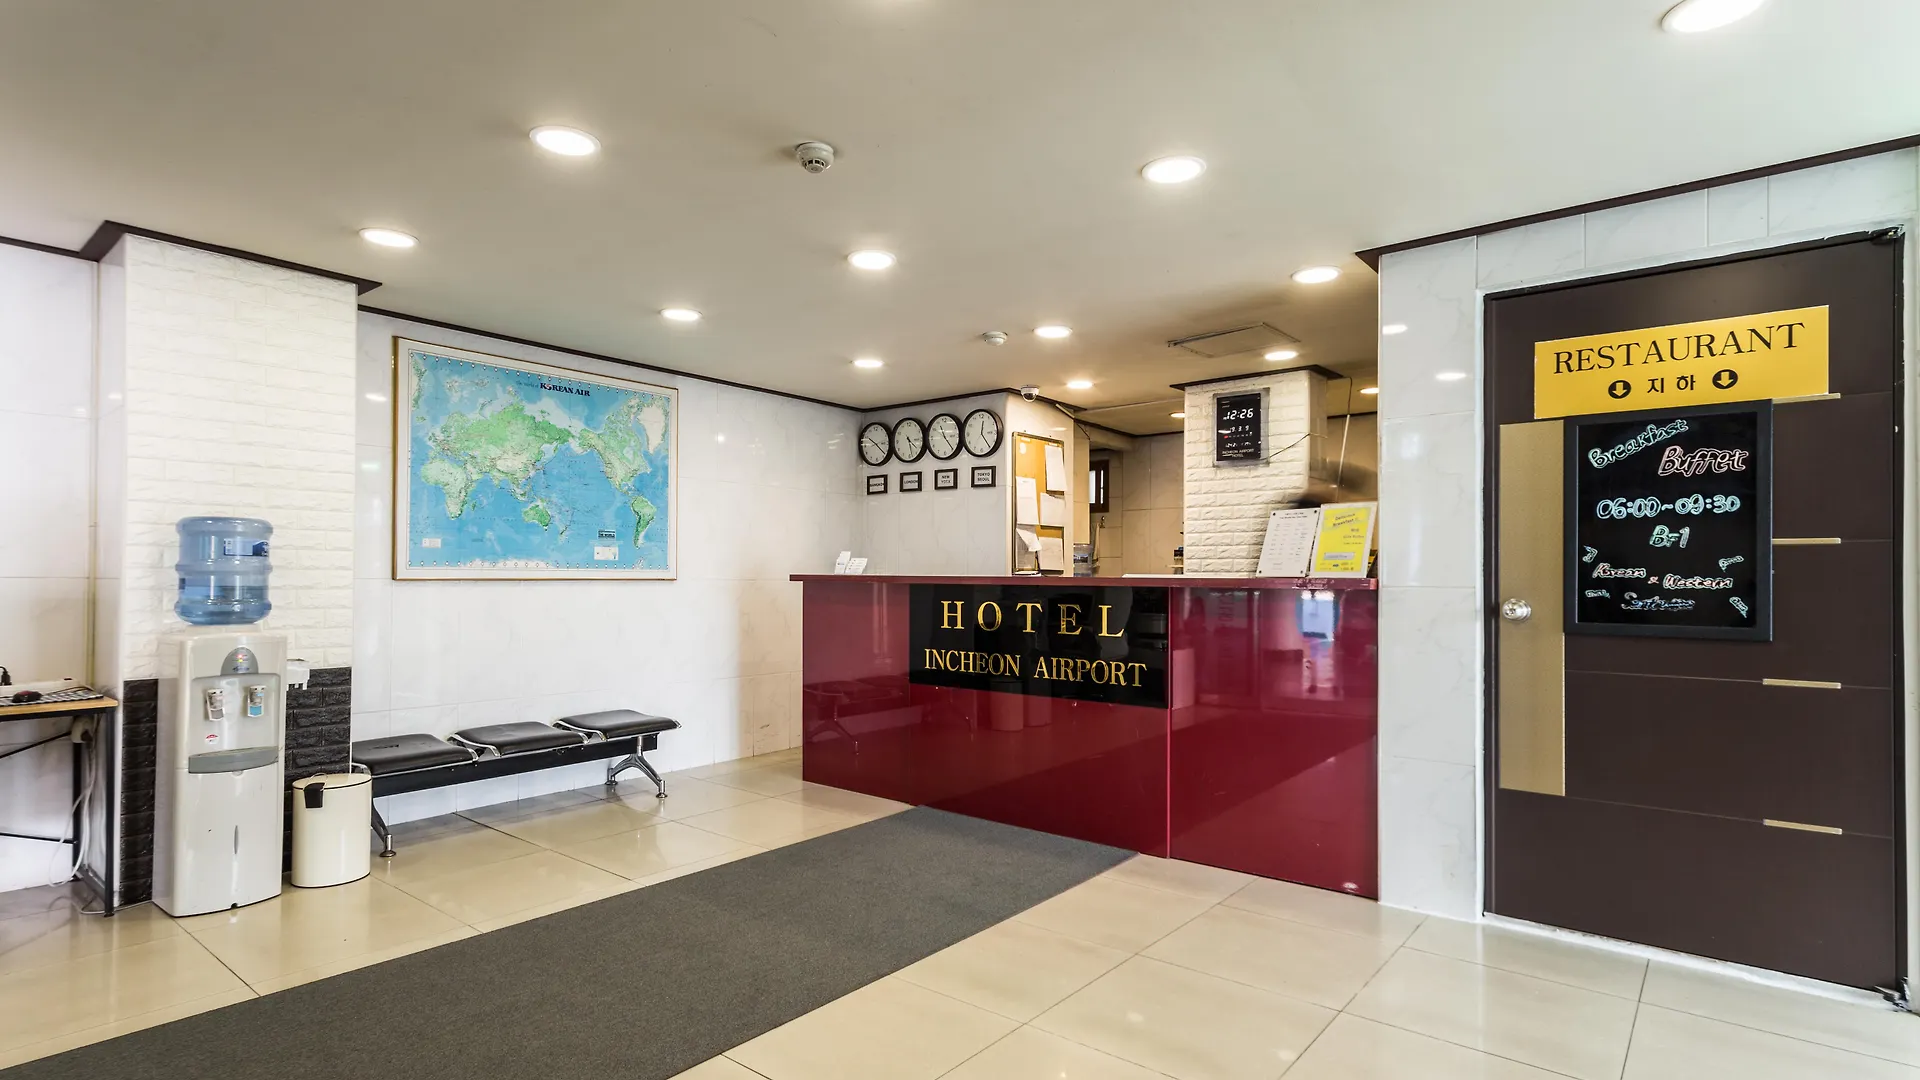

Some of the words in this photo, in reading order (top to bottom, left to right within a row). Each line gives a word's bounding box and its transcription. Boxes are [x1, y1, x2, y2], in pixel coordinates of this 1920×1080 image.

[1553, 322, 1805, 374] RESTAURANT
[1227, 408, 1254, 420] 12:26
[1588, 419, 1689, 468] Breakfast
[1658, 445, 1749, 477] Buffet
[1592, 563, 1646, 578] Korean
[1663, 574, 1733, 589] Western
[940, 601, 1124, 637] HOTEL
[924, 648, 1021, 677] INCHEON
[1034, 656, 1147, 687] AIRPORT
